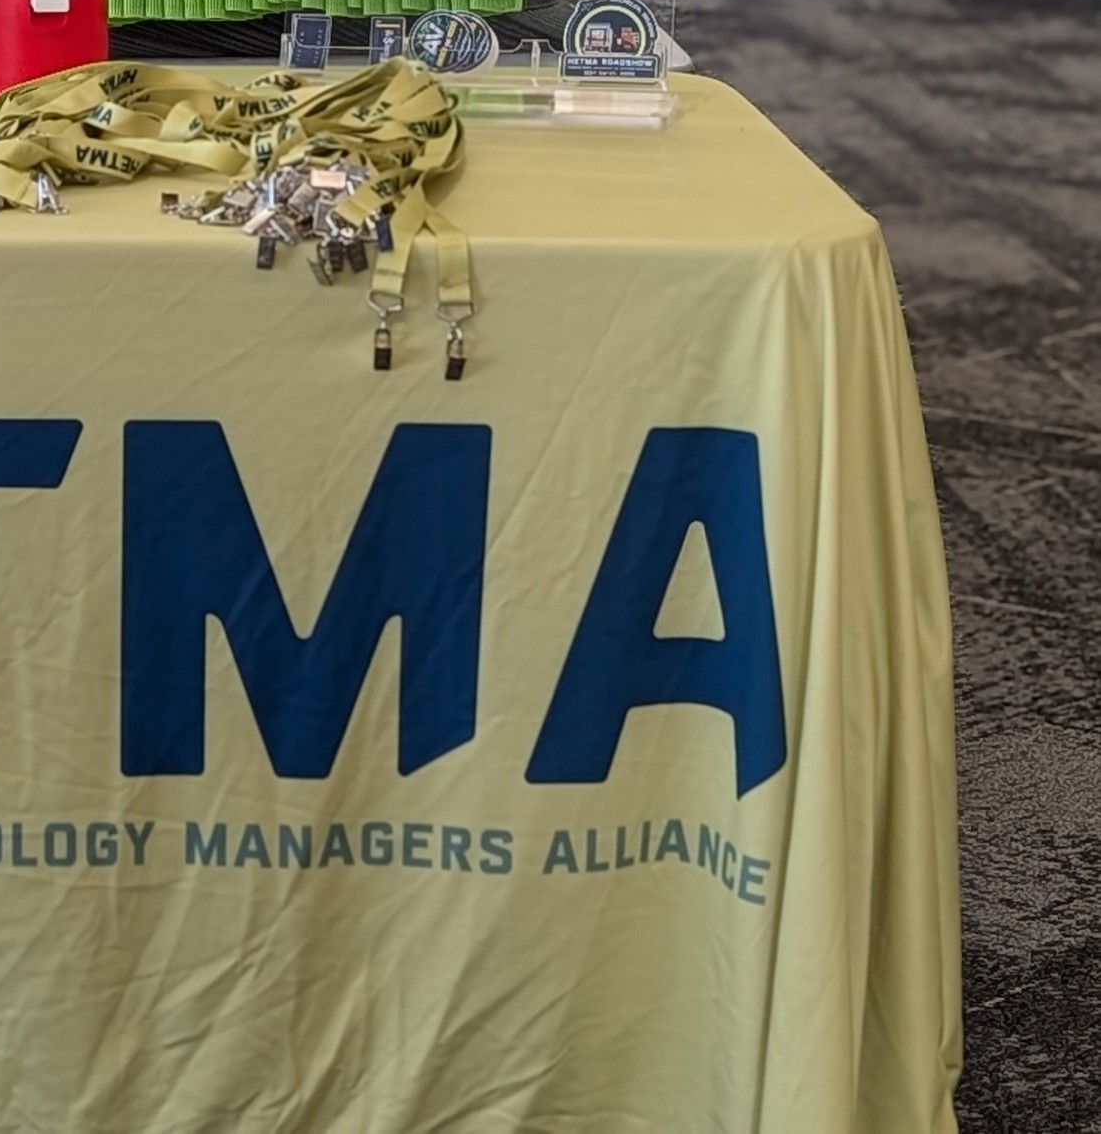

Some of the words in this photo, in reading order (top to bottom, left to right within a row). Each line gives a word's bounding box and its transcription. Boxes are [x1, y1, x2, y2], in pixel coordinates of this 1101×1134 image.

[601, 58, 654, 67] ROADSHOW
[238, 94, 297, 118] HETMA
[184, 820, 515, 875] MANAGERS
[543, 818, 772, 907] ALLIANCE
